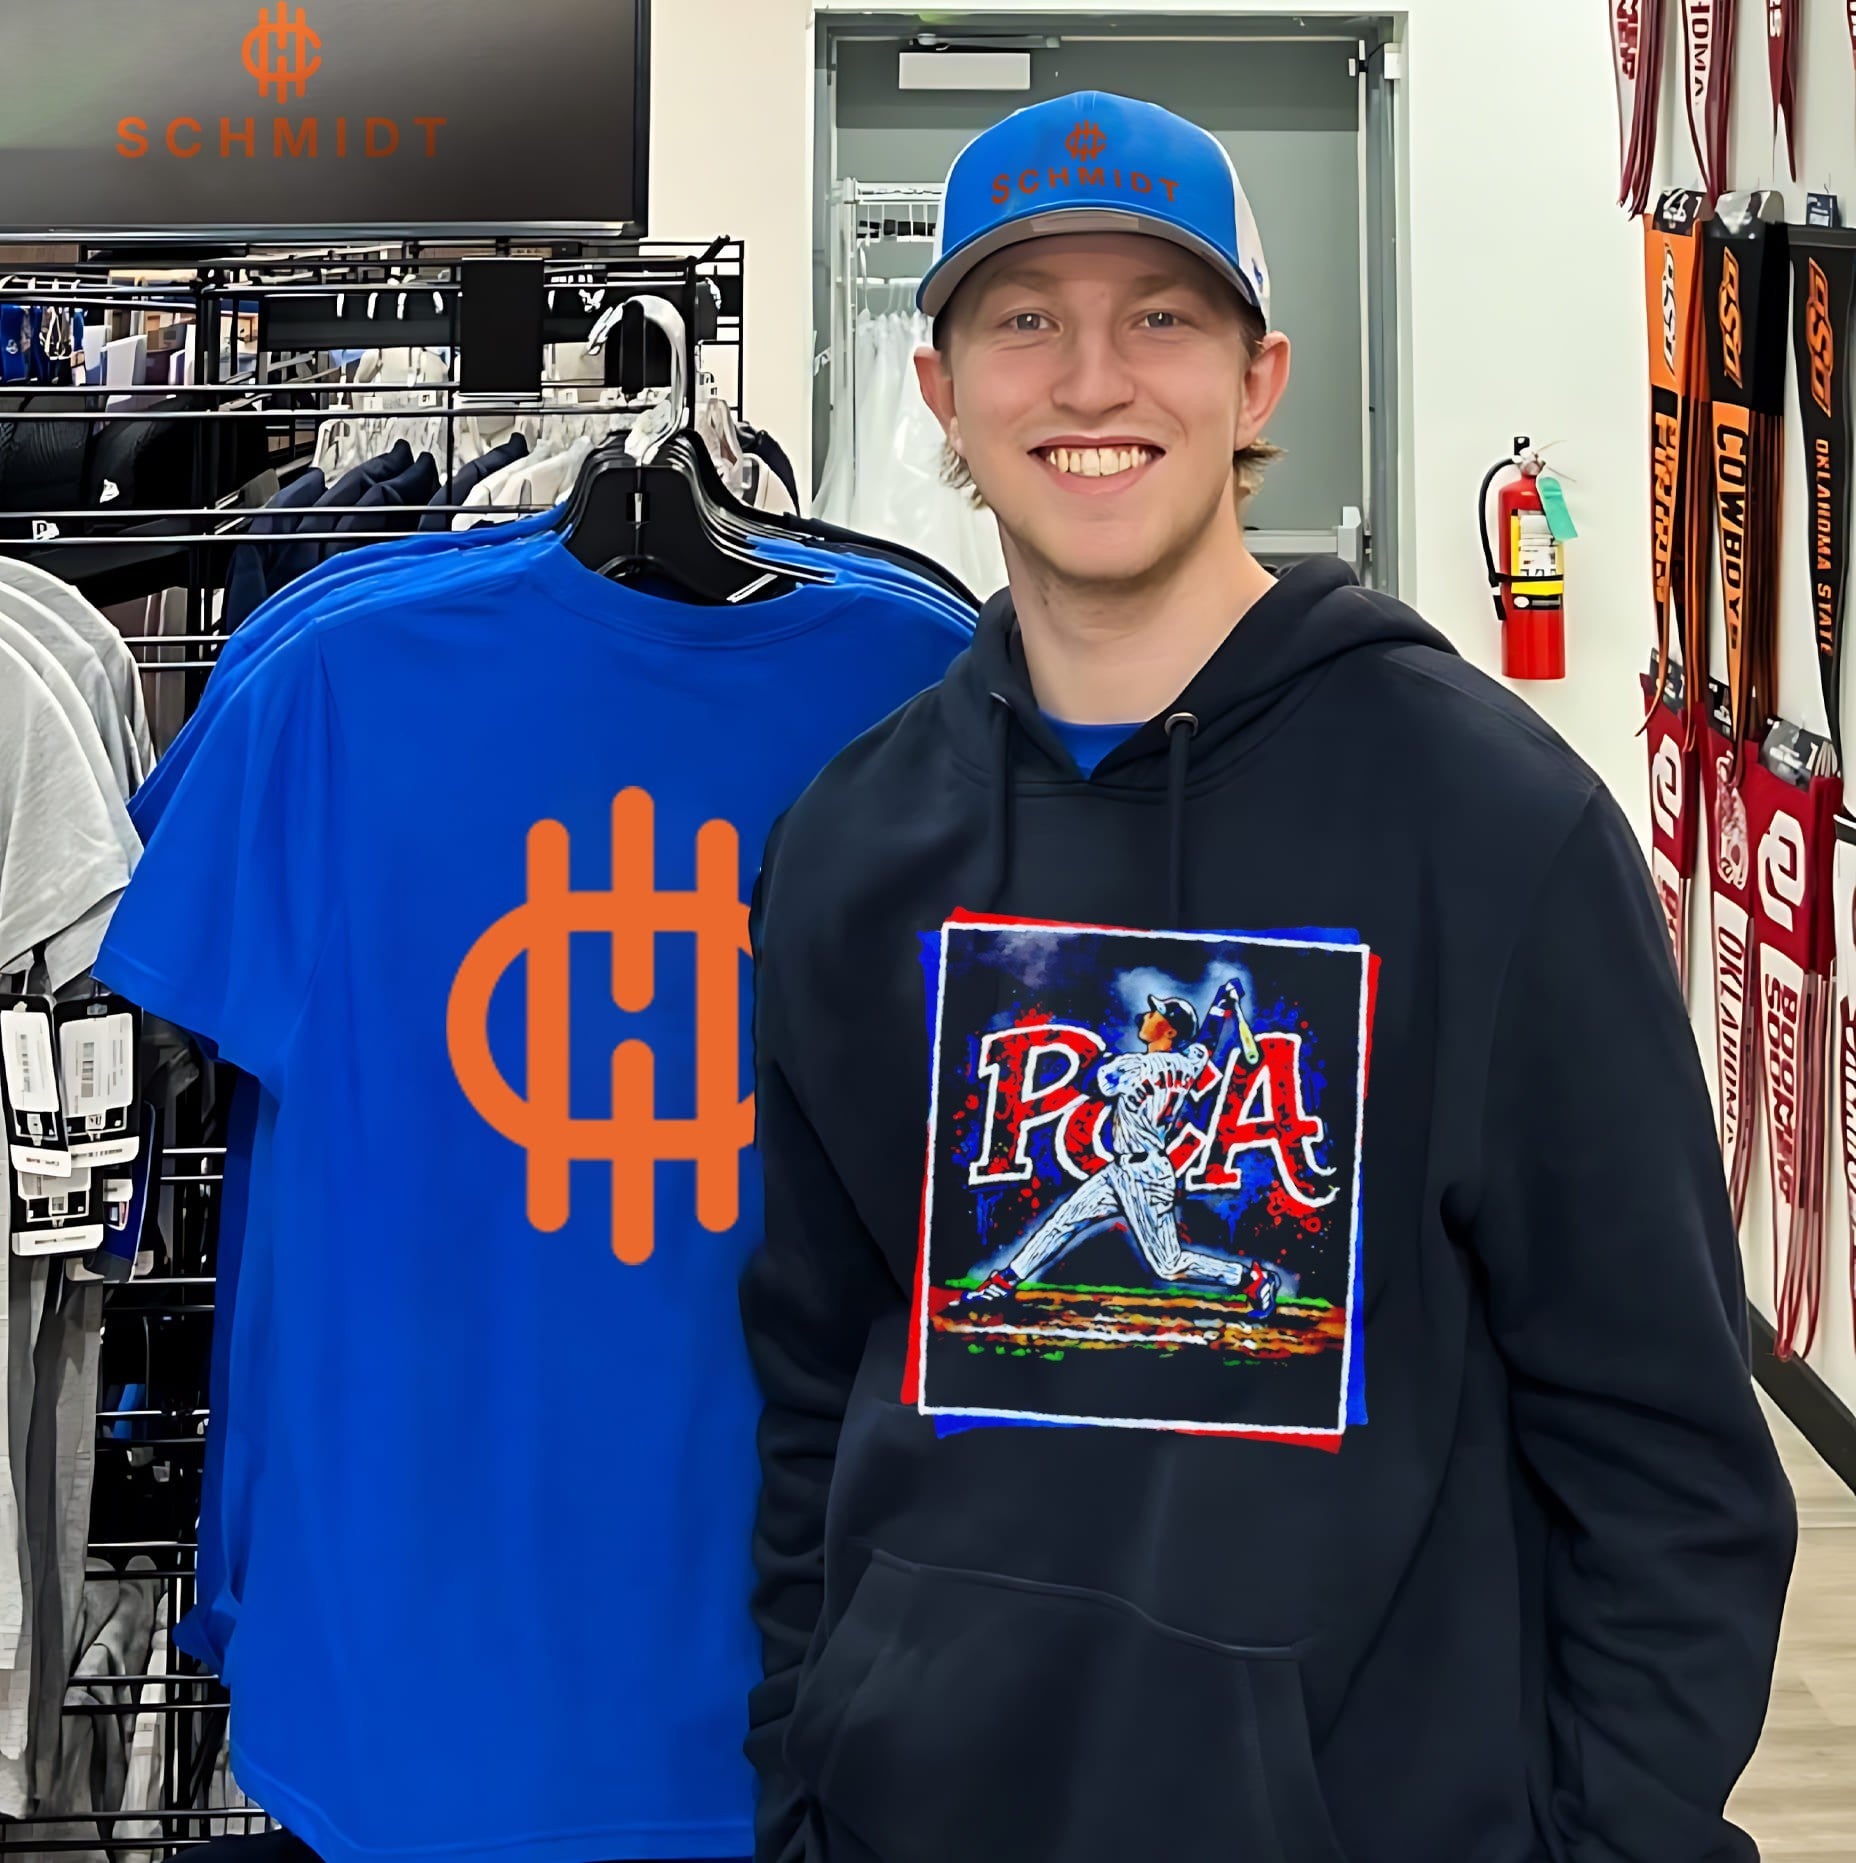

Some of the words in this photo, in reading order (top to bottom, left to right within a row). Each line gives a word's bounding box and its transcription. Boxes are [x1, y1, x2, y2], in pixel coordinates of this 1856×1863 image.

[116, 117, 447, 158] SCHMIDT
[991, 167, 1179, 204] SCHMIDT
[1815, 438, 1832, 570] OKLAHOMA
[1717, 926, 1746, 1144] OKLAHOMA
